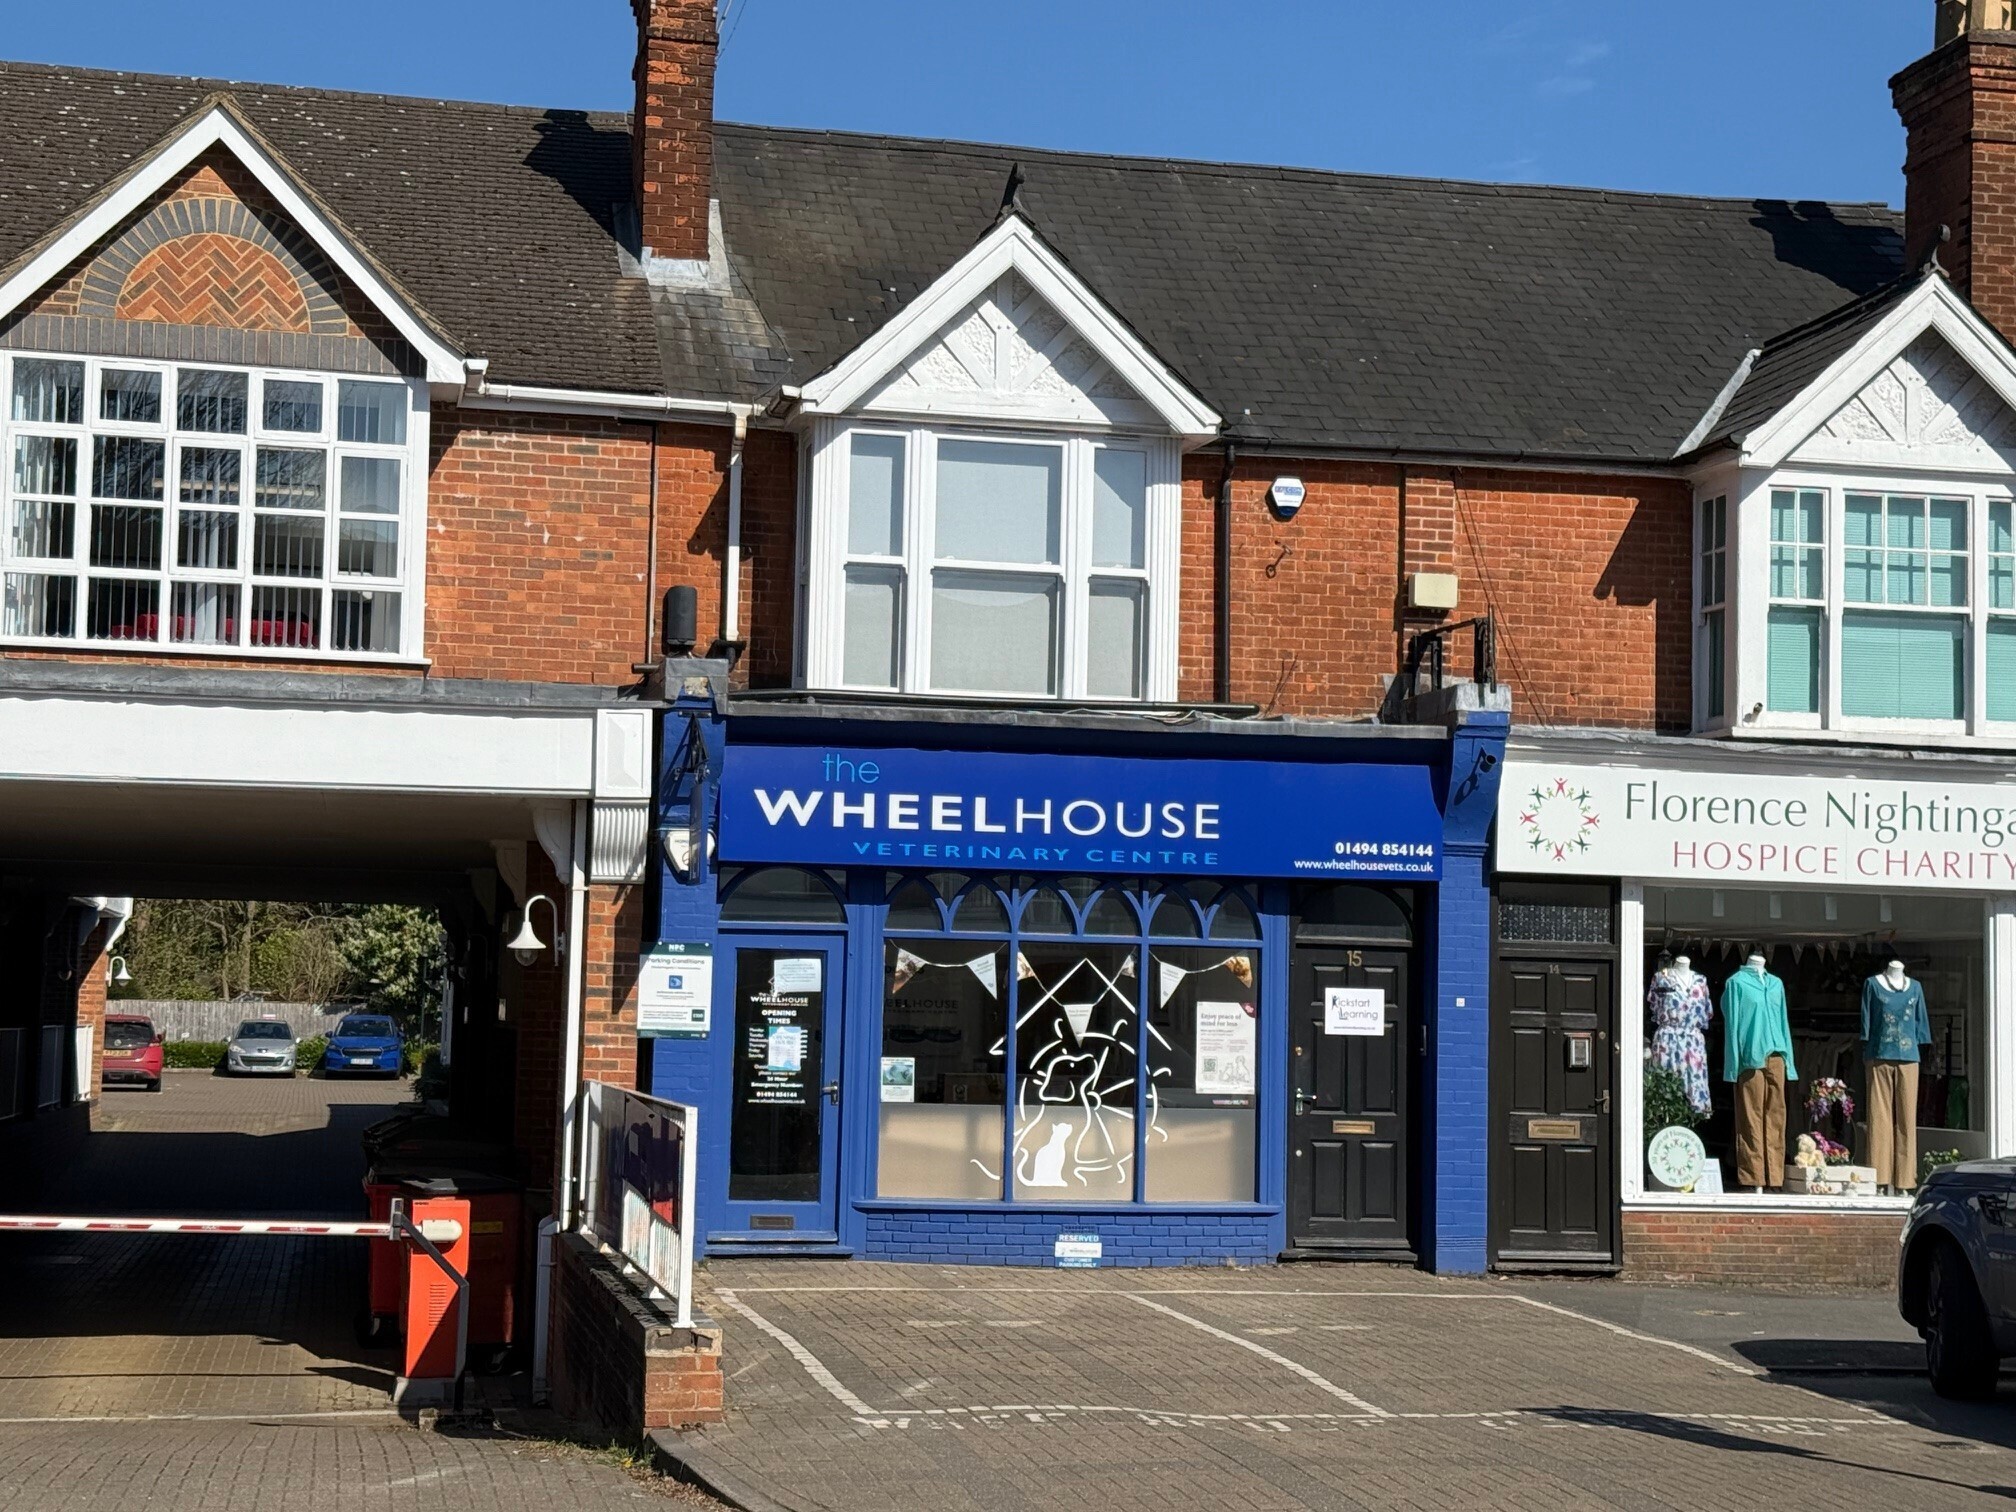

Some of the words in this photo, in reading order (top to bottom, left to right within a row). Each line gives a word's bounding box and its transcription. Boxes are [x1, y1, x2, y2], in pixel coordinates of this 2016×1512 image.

[822, 753, 880, 783] the
[1626, 780, 1807, 827] Florence
[753, 789, 1220, 839] WHEELHOUSE
[853, 842, 1070, 861] VETERINARY
[1086, 849, 1218, 865] CENTRE
[1335, 842, 1379, 855] 01494
[1382, 843, 1434, 857] 854144
[1294, 859, 1434, 873] www.wheelhousevets.co.uk
[1673, 841, 1838, 874] HOSPICE
[1857, 847, 2016, 880] CHARITY
[648, 957, 671, 965] Parking
[1347, 950, 1362, 967] 15
[1549, 964, 1560, 974] 14
[1332, 994, 1370, 1010] Kickstart
[1338, 1007, 1379, 1020] Learning
[1059, 1234, 1100, 1242] RESERVED
